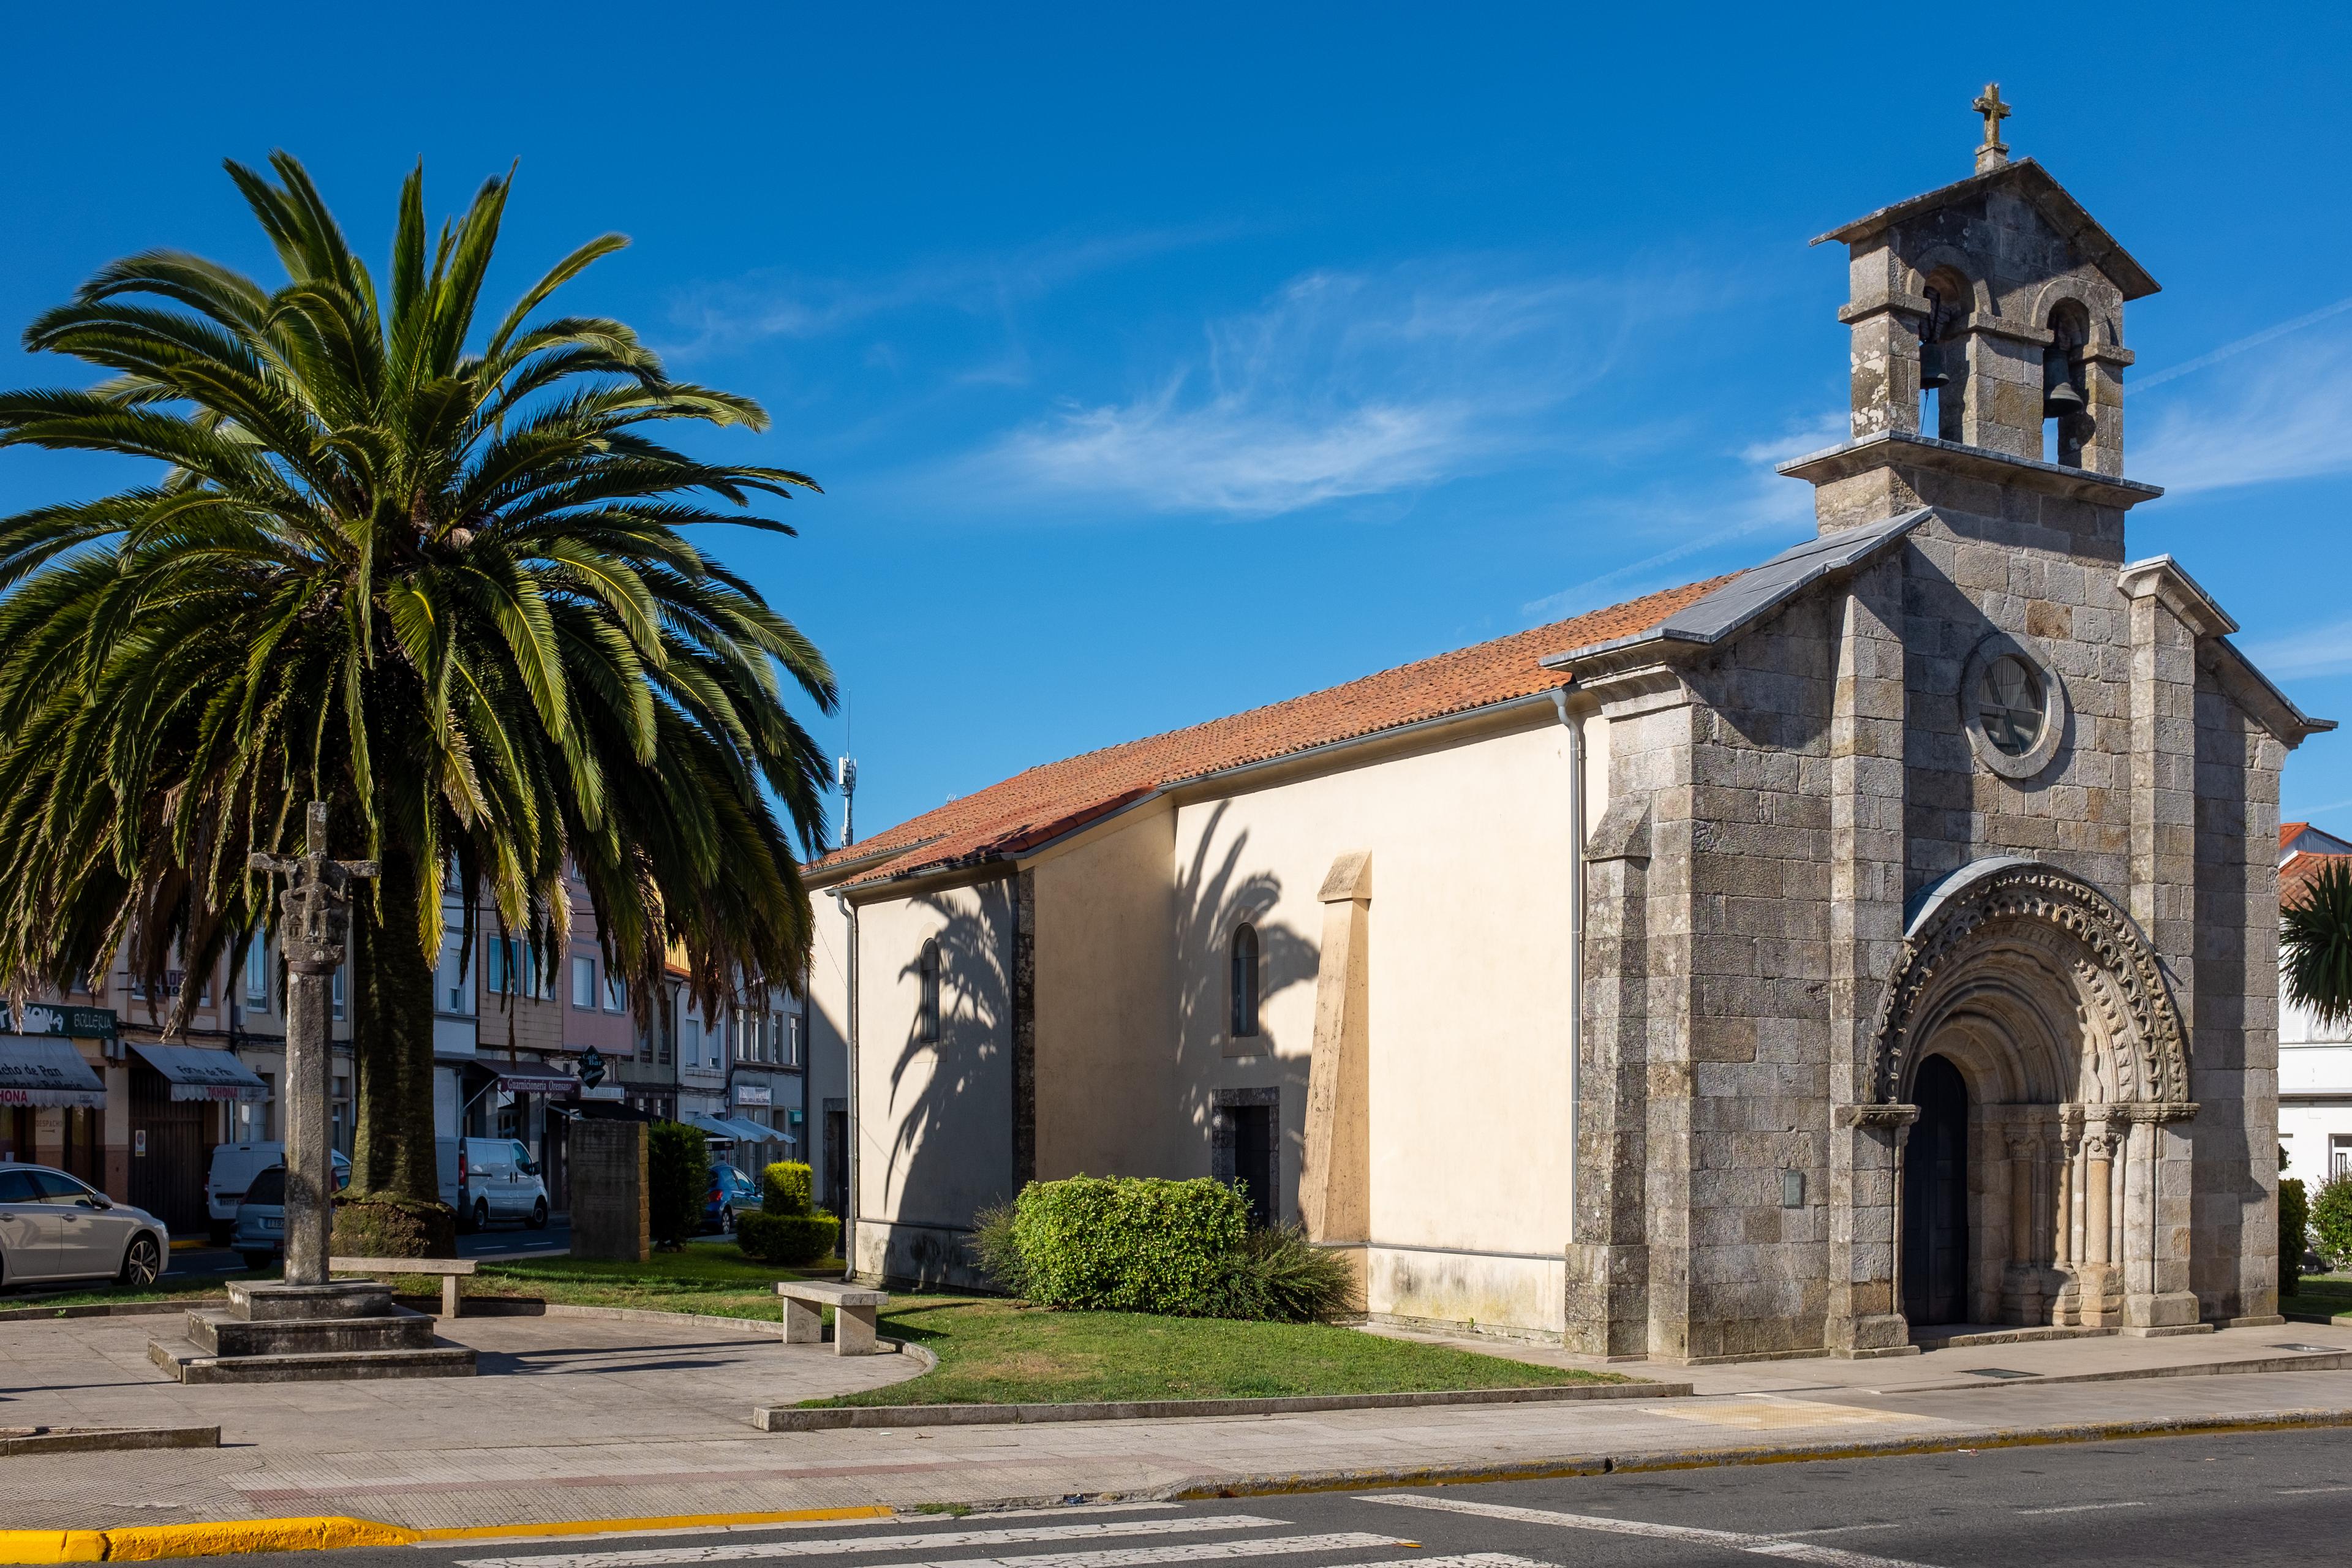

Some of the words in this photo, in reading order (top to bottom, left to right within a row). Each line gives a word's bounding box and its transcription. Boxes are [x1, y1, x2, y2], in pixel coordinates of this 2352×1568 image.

[74, 1013, 112, 1031] BOLLERIA
[0, 1063, 22, 1075] cho
[24, 1063, 39, 1076] de
[37, 1065, 63, 1076] Pan
[206, 1087, 238, 1098] TAHONA
